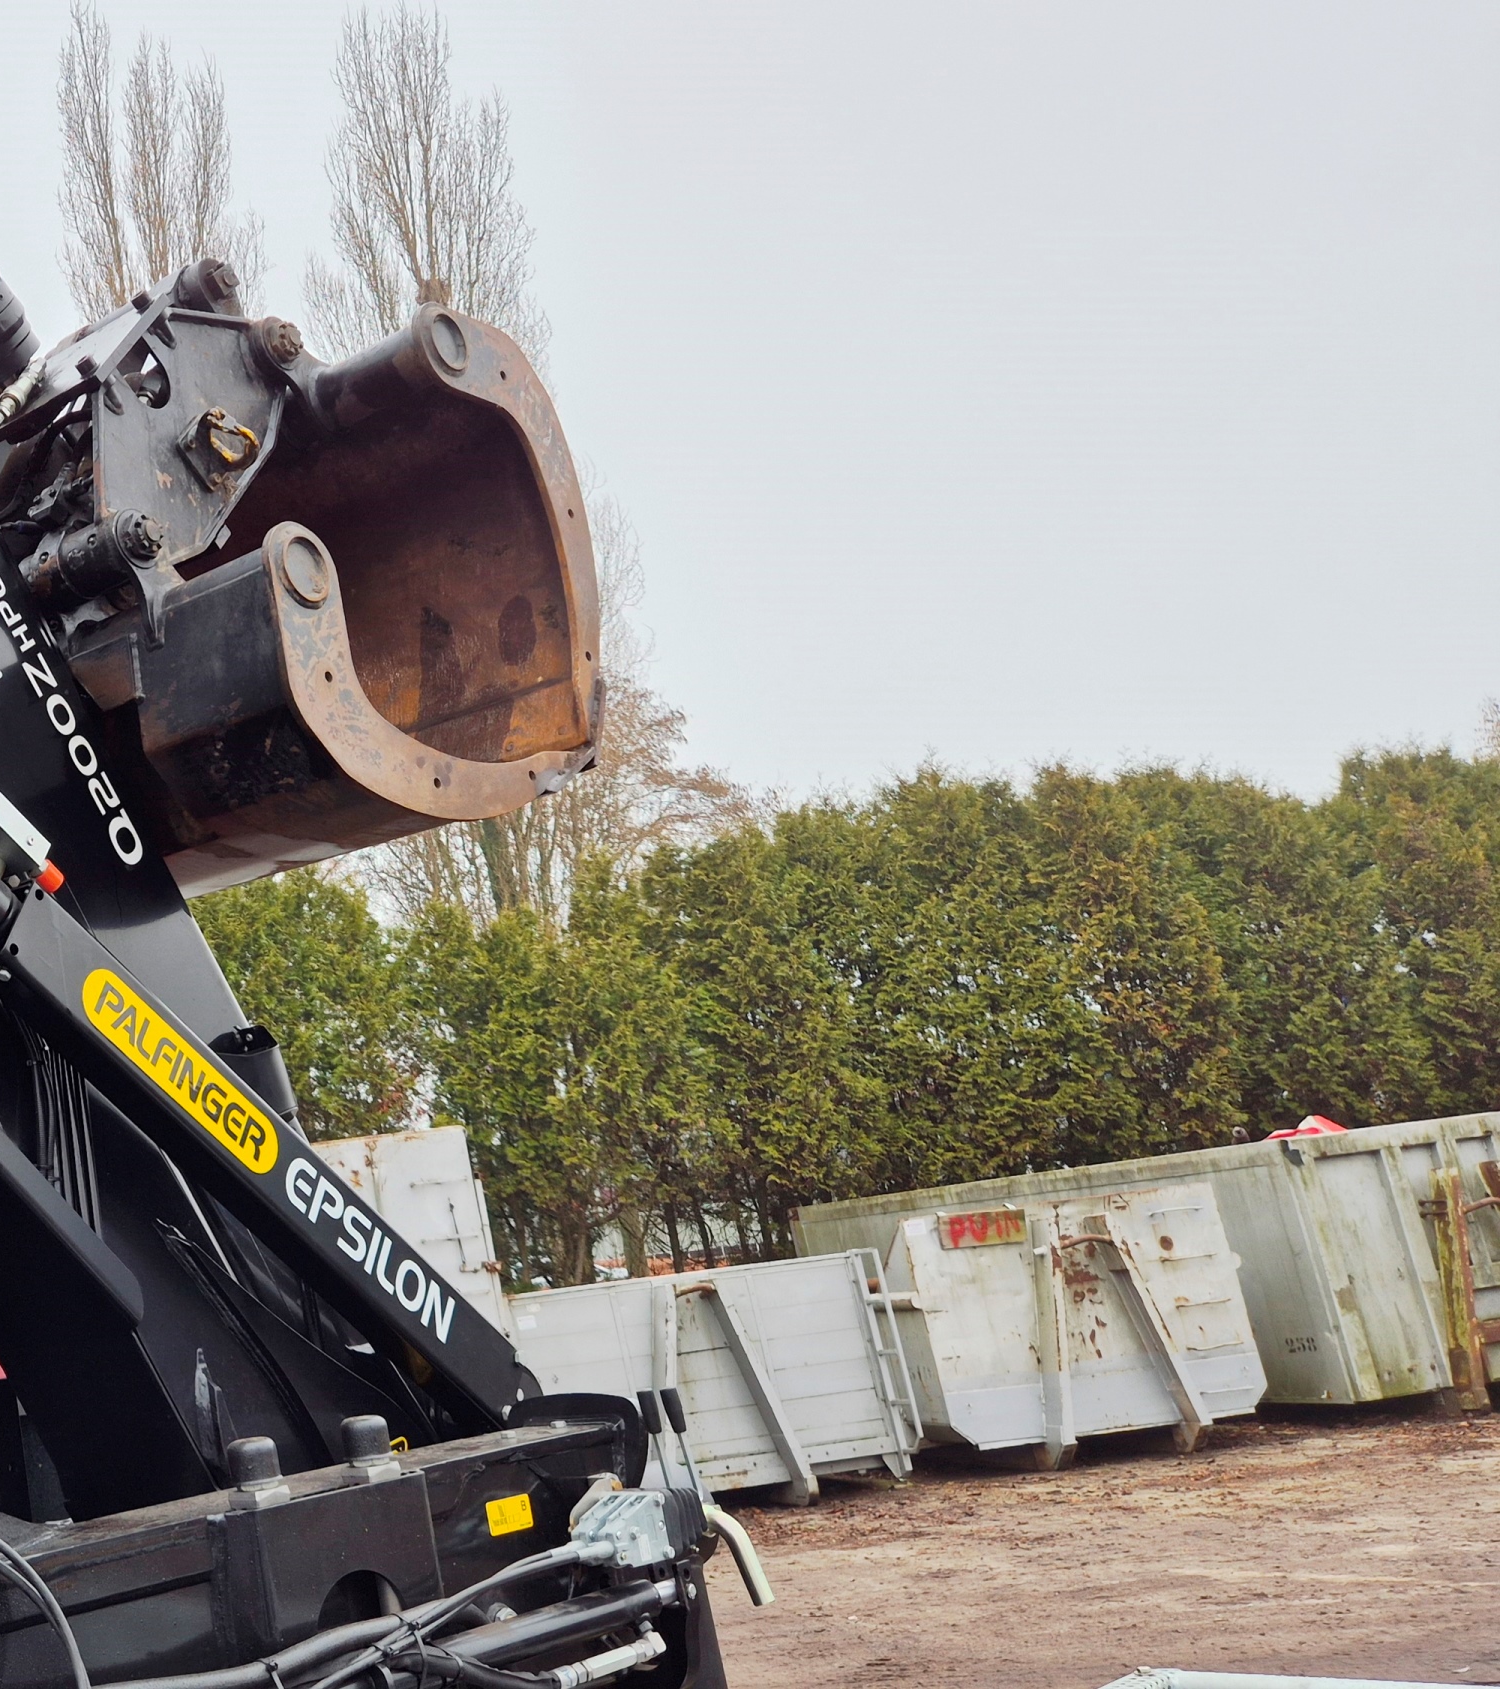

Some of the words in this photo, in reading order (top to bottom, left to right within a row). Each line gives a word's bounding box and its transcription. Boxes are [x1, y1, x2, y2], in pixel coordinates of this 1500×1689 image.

[22, 652, 144, 866] Q200Z
[94, 981, 266, 1162] PALFINGER
[285, 1157, 455, 1345] EPSILON
[1285, 1337, 1318, 1353] 258
